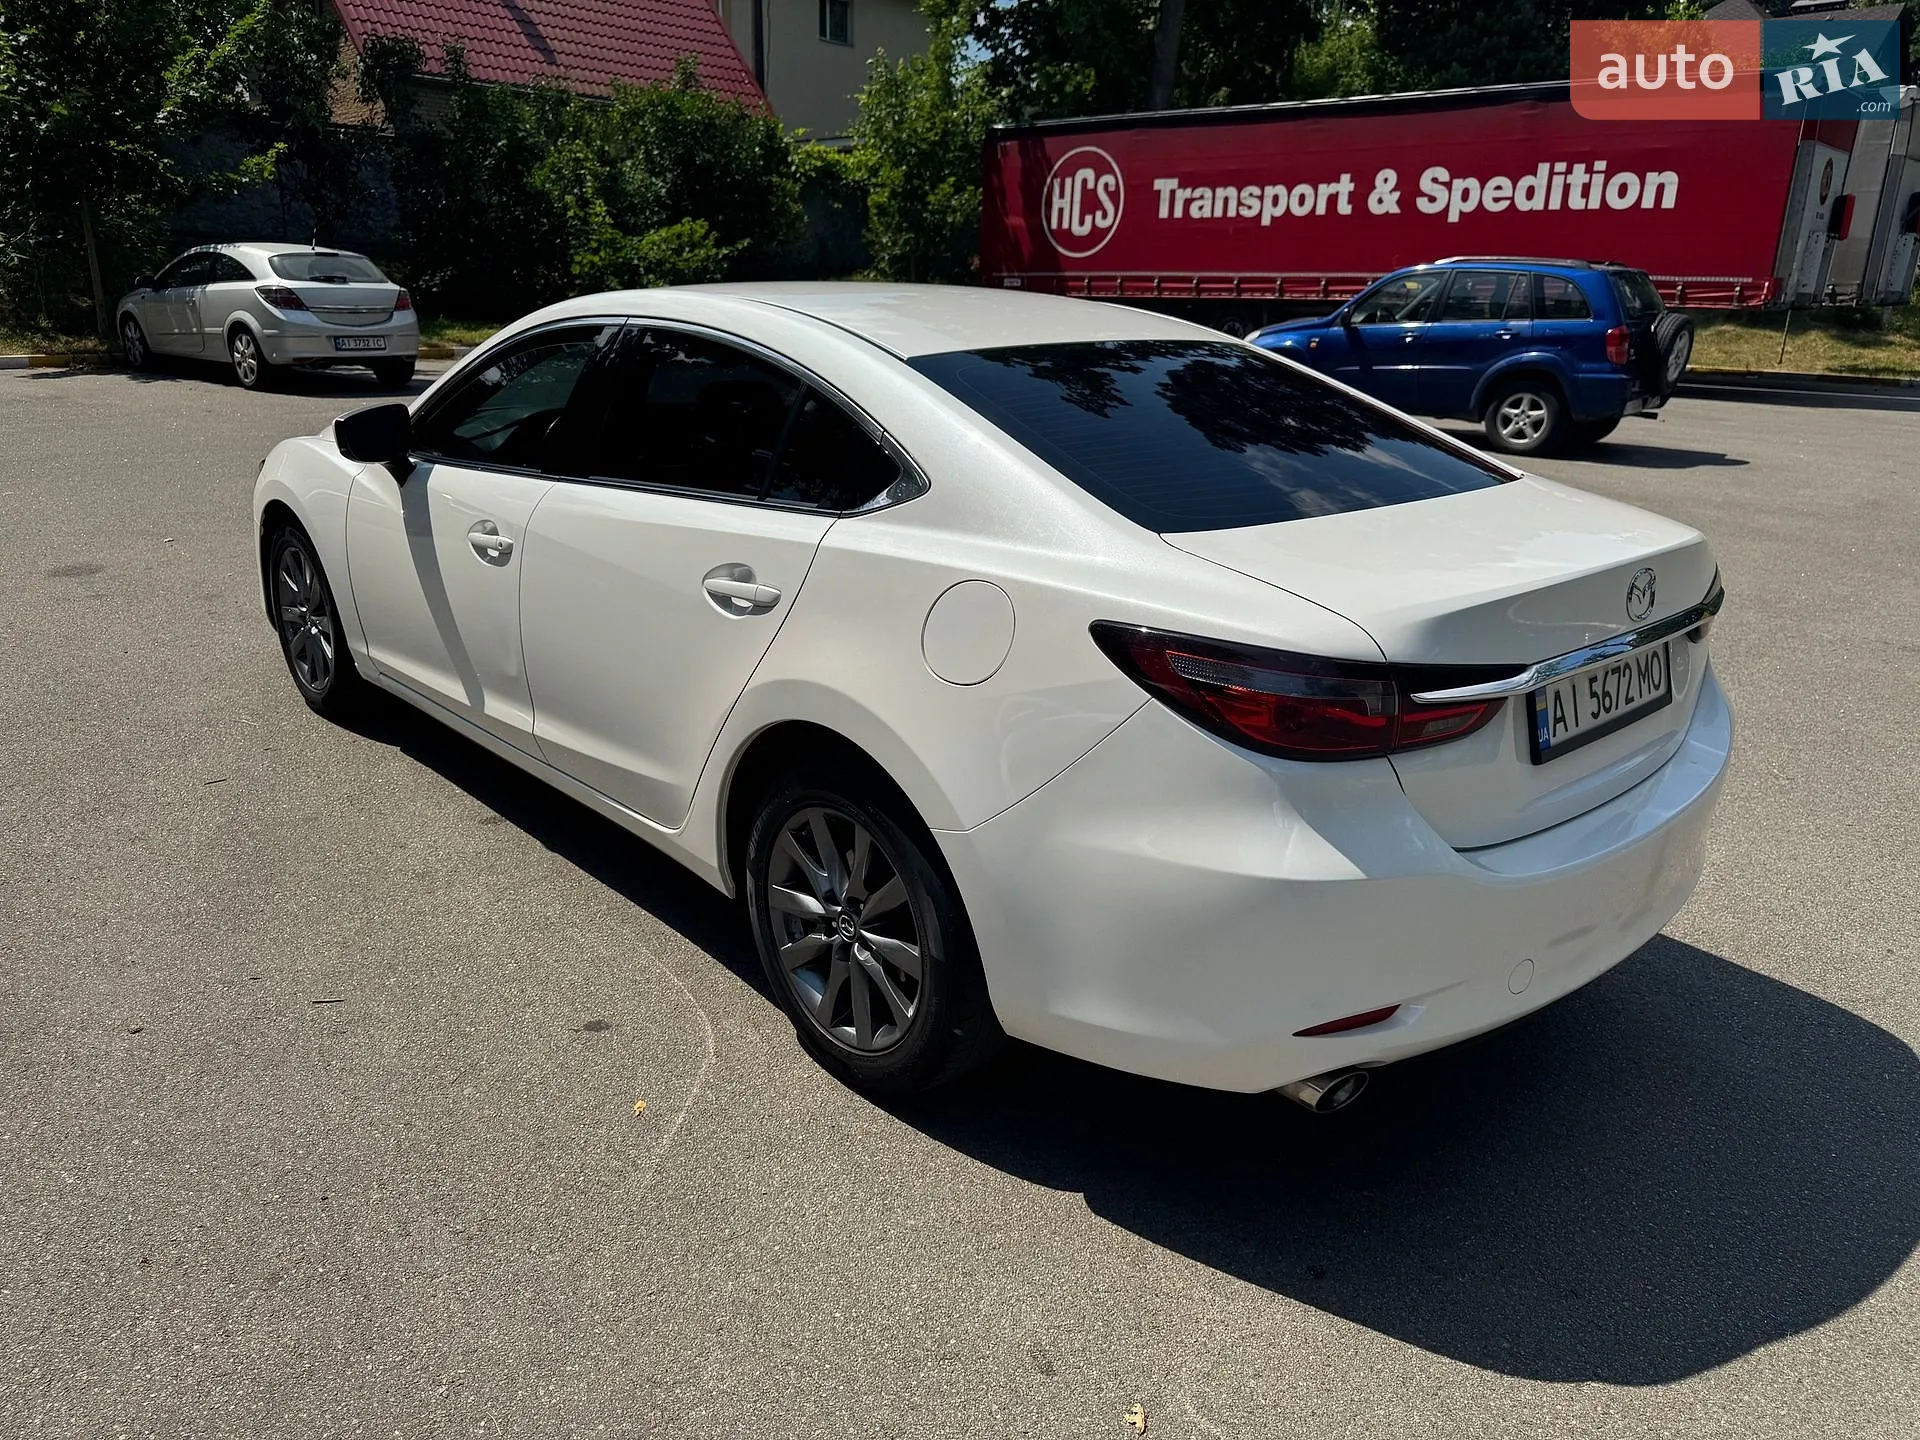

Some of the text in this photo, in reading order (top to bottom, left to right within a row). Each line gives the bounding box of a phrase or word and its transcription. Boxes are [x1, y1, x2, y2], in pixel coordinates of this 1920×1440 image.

[1050, 168, 1116, 237] HCS
[1153, 160, 1679, 226] Transport & Spedition
[1552, 650, 1663, 738] AI 5672 MO
[1538, 727, 1549, 743] UA
